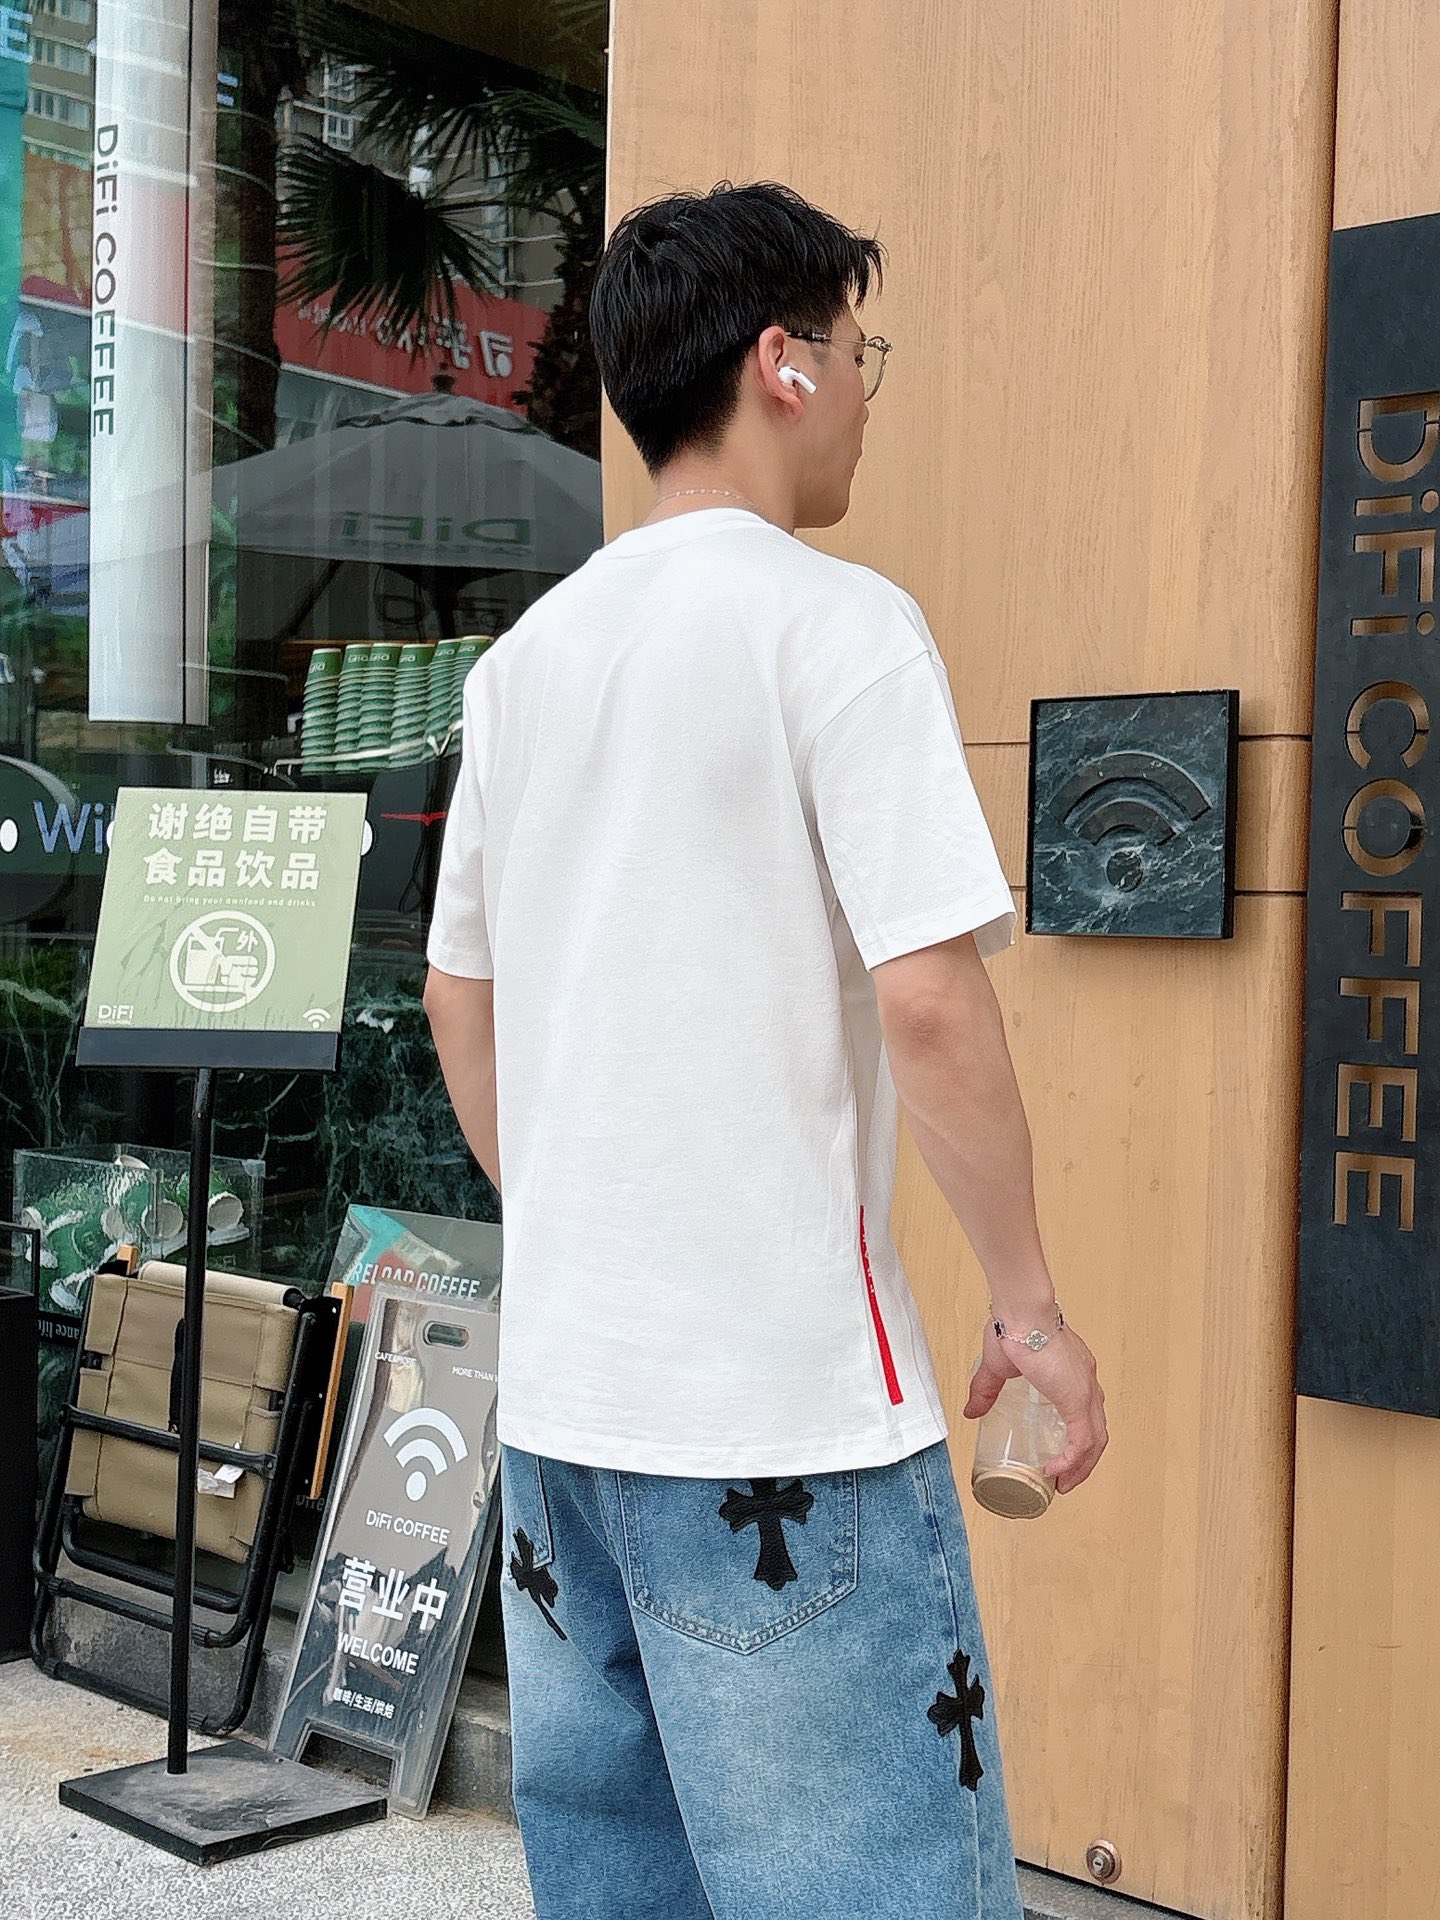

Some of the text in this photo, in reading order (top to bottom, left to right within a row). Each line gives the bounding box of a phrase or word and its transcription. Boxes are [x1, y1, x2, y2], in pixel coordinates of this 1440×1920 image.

[93, 123, 119, 438] DiFi COFFEE
[148, 802, 328, 844] 谢绝自带
[1332, 390, 1440, 1233] DiFi COFFEE
[143, 847, 320, 890] 食品饮品
[143, 895, 156, 903] Do
[158, 895, 173, 903] not
[176, 895, 200, 905] bring
[202, 896, 222, 906] your
[287, 898, 316, 907] drinks
[98, 1004, 134, 1020] DiFi
[415, 1272, 481, 1299] COFFEE
[451, 1366, 473, 1378] MORE
[474, 1370, 493, 1382] THAN
[366, 1509, 450, 1546] DiFi COFFEE
[338, 1556, 449, 1631] 营业中
[336, 1631, 420, 1675] WELCOME
